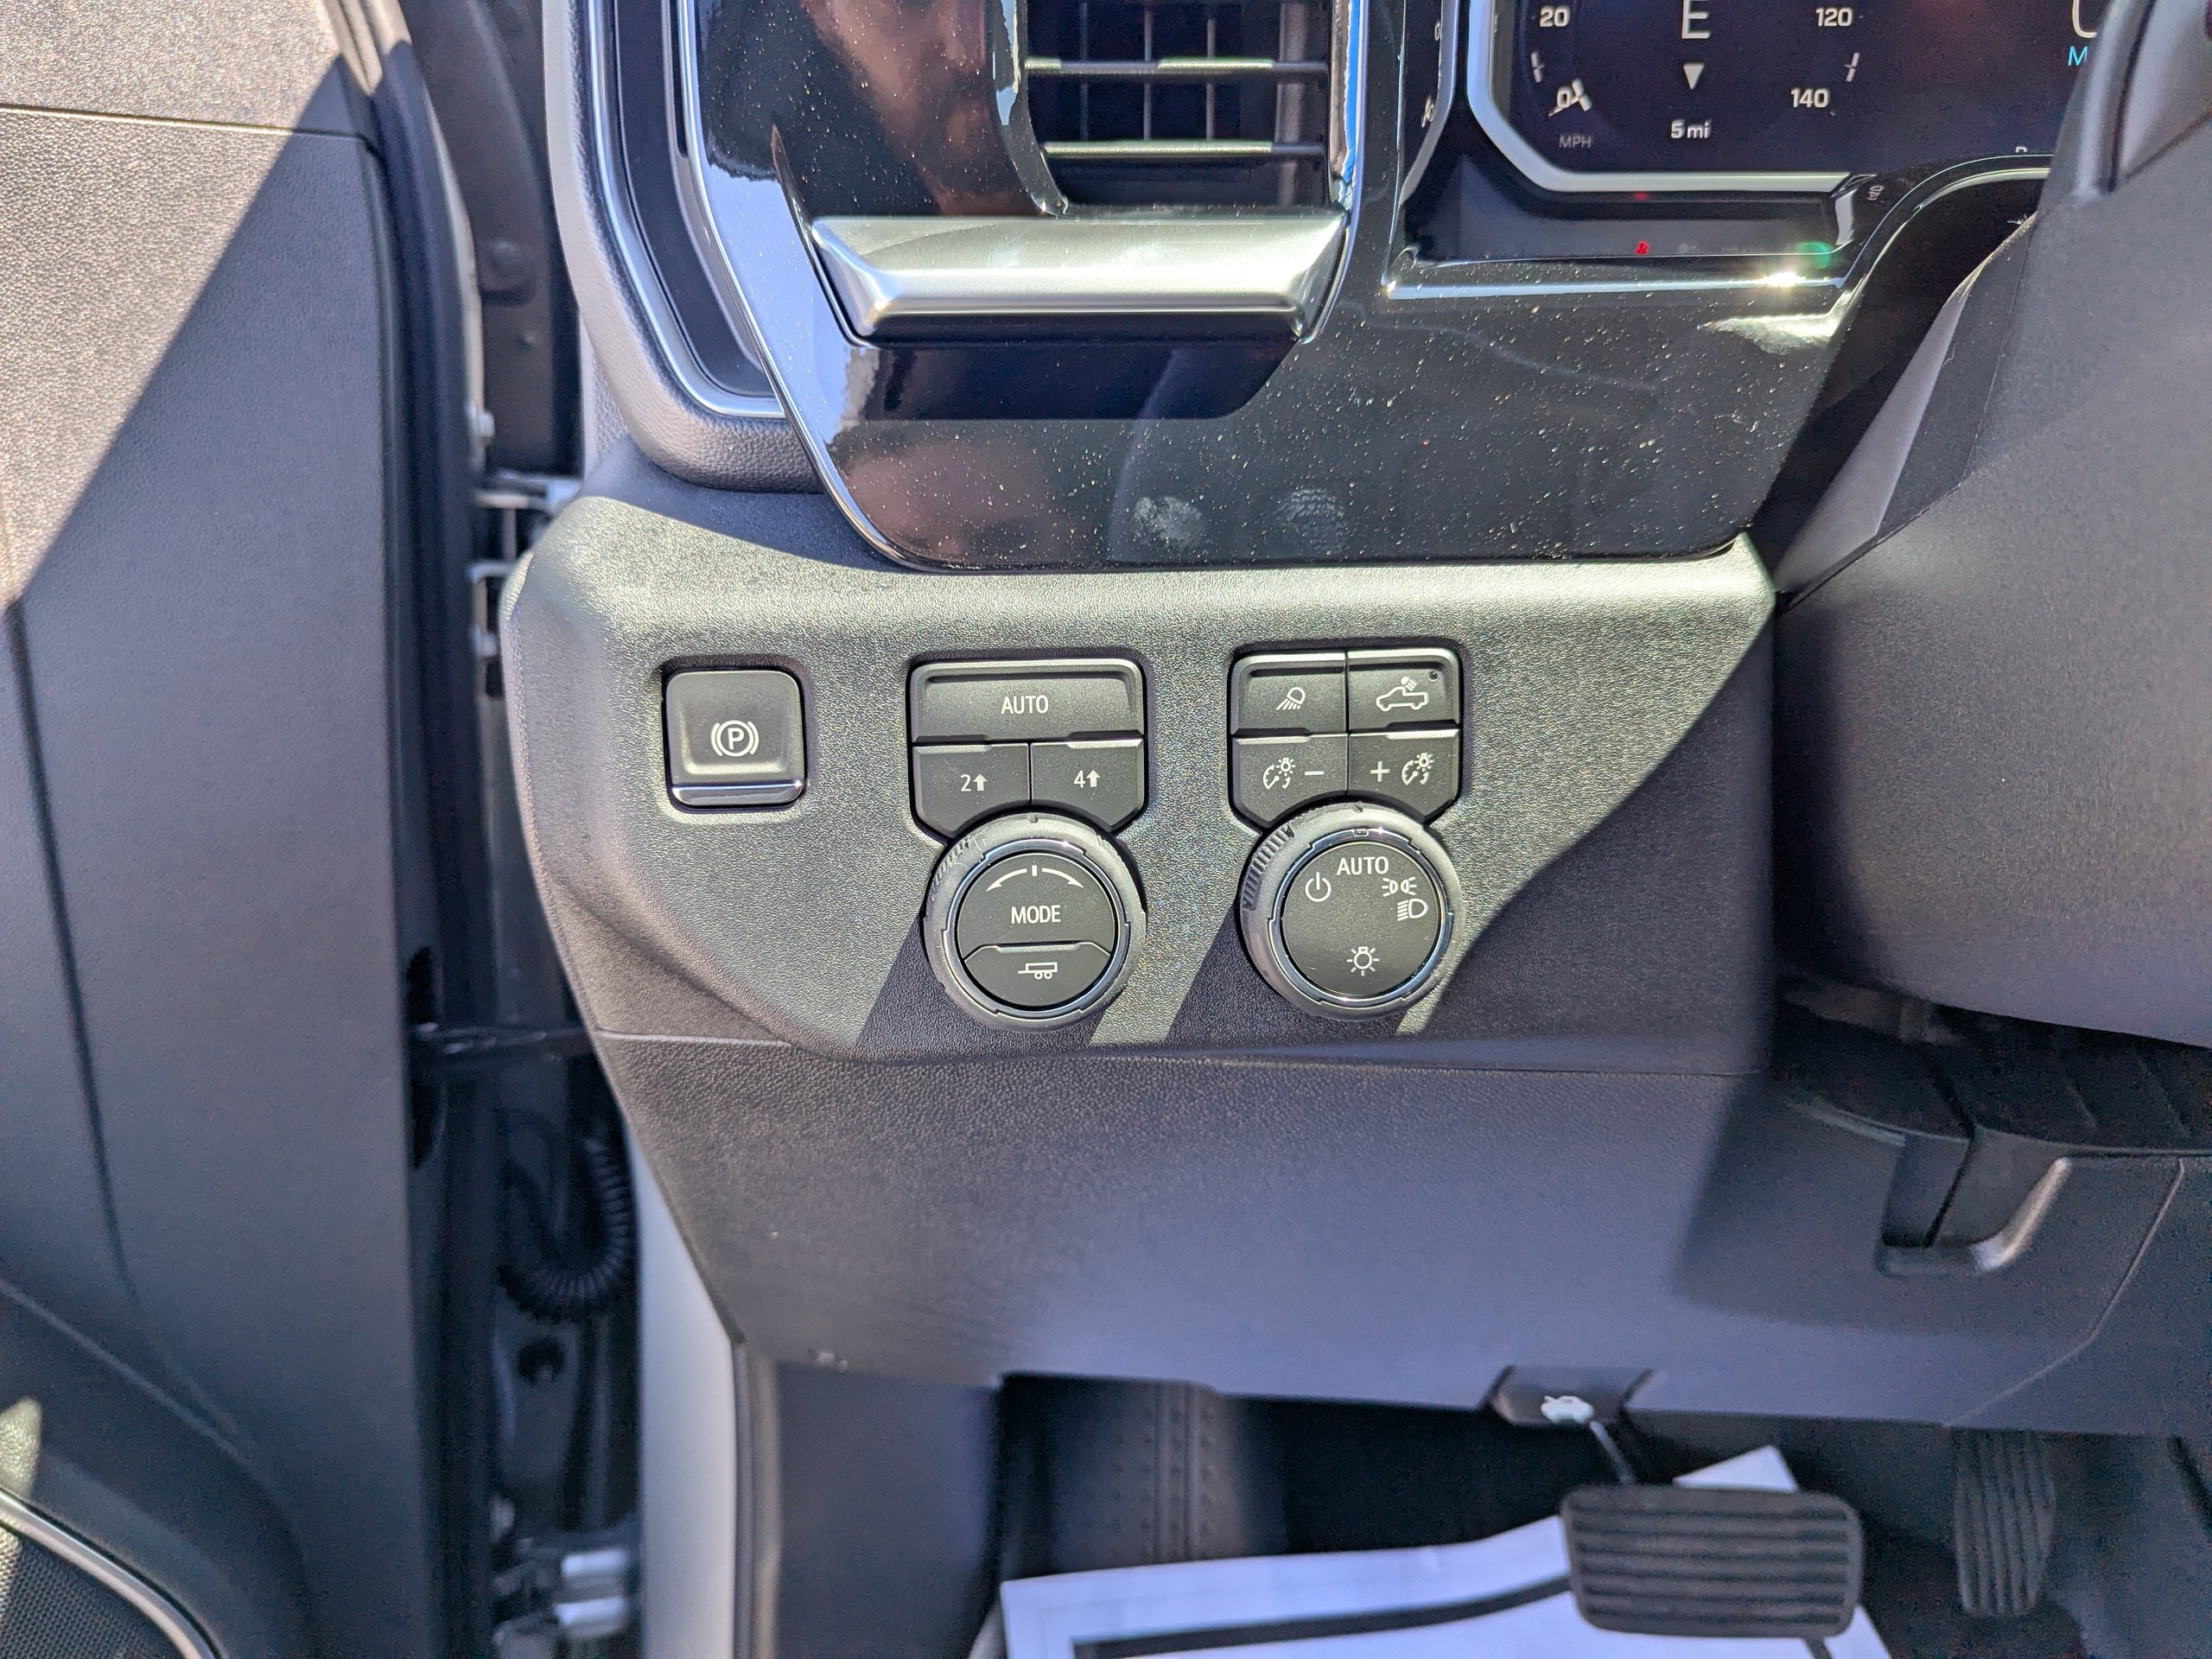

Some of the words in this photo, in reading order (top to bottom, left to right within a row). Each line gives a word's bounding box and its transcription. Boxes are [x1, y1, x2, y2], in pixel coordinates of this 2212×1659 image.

[1540, 7, 1570, 28] 20
[1681, 0, 1712, 40] E
[1815, 7, 1853, 28] 120
[1790, 87, 1830, 109] 140
[1670, 119, 1686, 139] 5
[1687, 119, 1713, 139] mi
[1558, 135, 1592, 149] MPH
[1000, 695, 1050, 715] AUTO
[727, 728, 745, 748] P
[1336, 855, 1389, 876] AUTO
[1010, 905, 1061, 925] MODE
